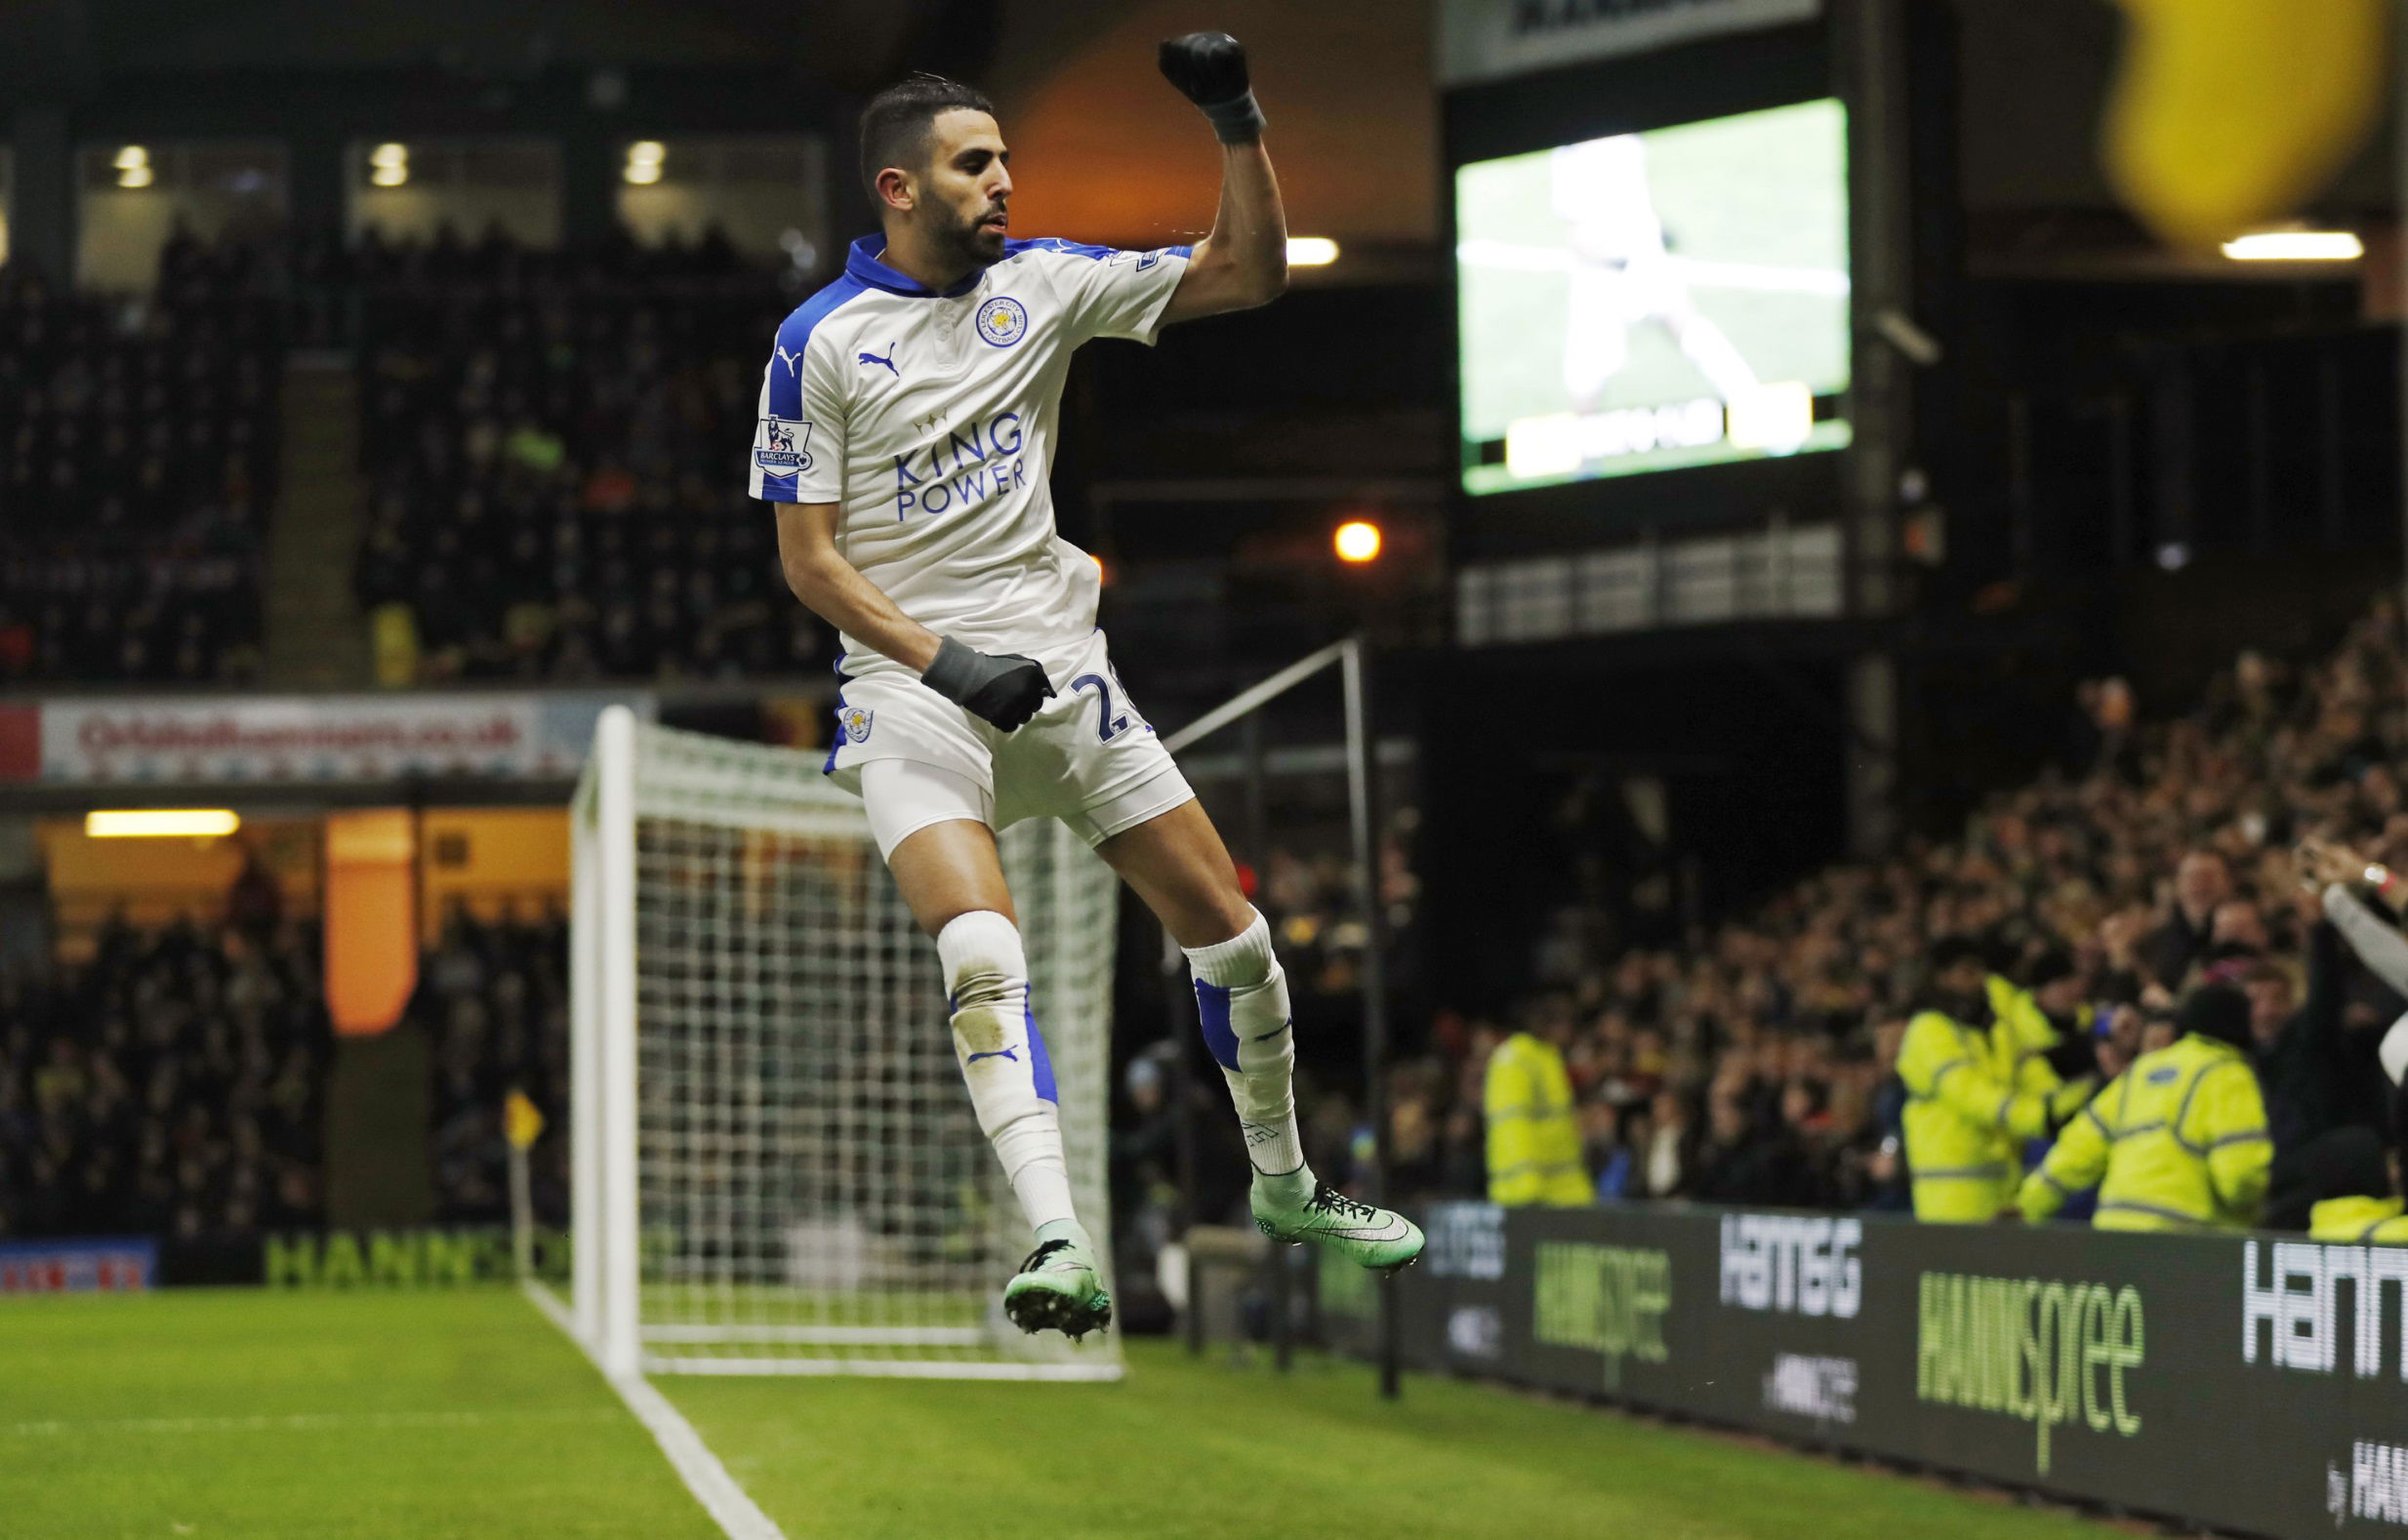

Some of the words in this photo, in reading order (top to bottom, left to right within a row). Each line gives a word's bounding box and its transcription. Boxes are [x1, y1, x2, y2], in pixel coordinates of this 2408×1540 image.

[759, 452, 796, 462] BARCLAYS
[894, 412, 1022, 491] KING
[897, 459, 1027, 522] POWER
[1069, 660, 1137, 745] 2
